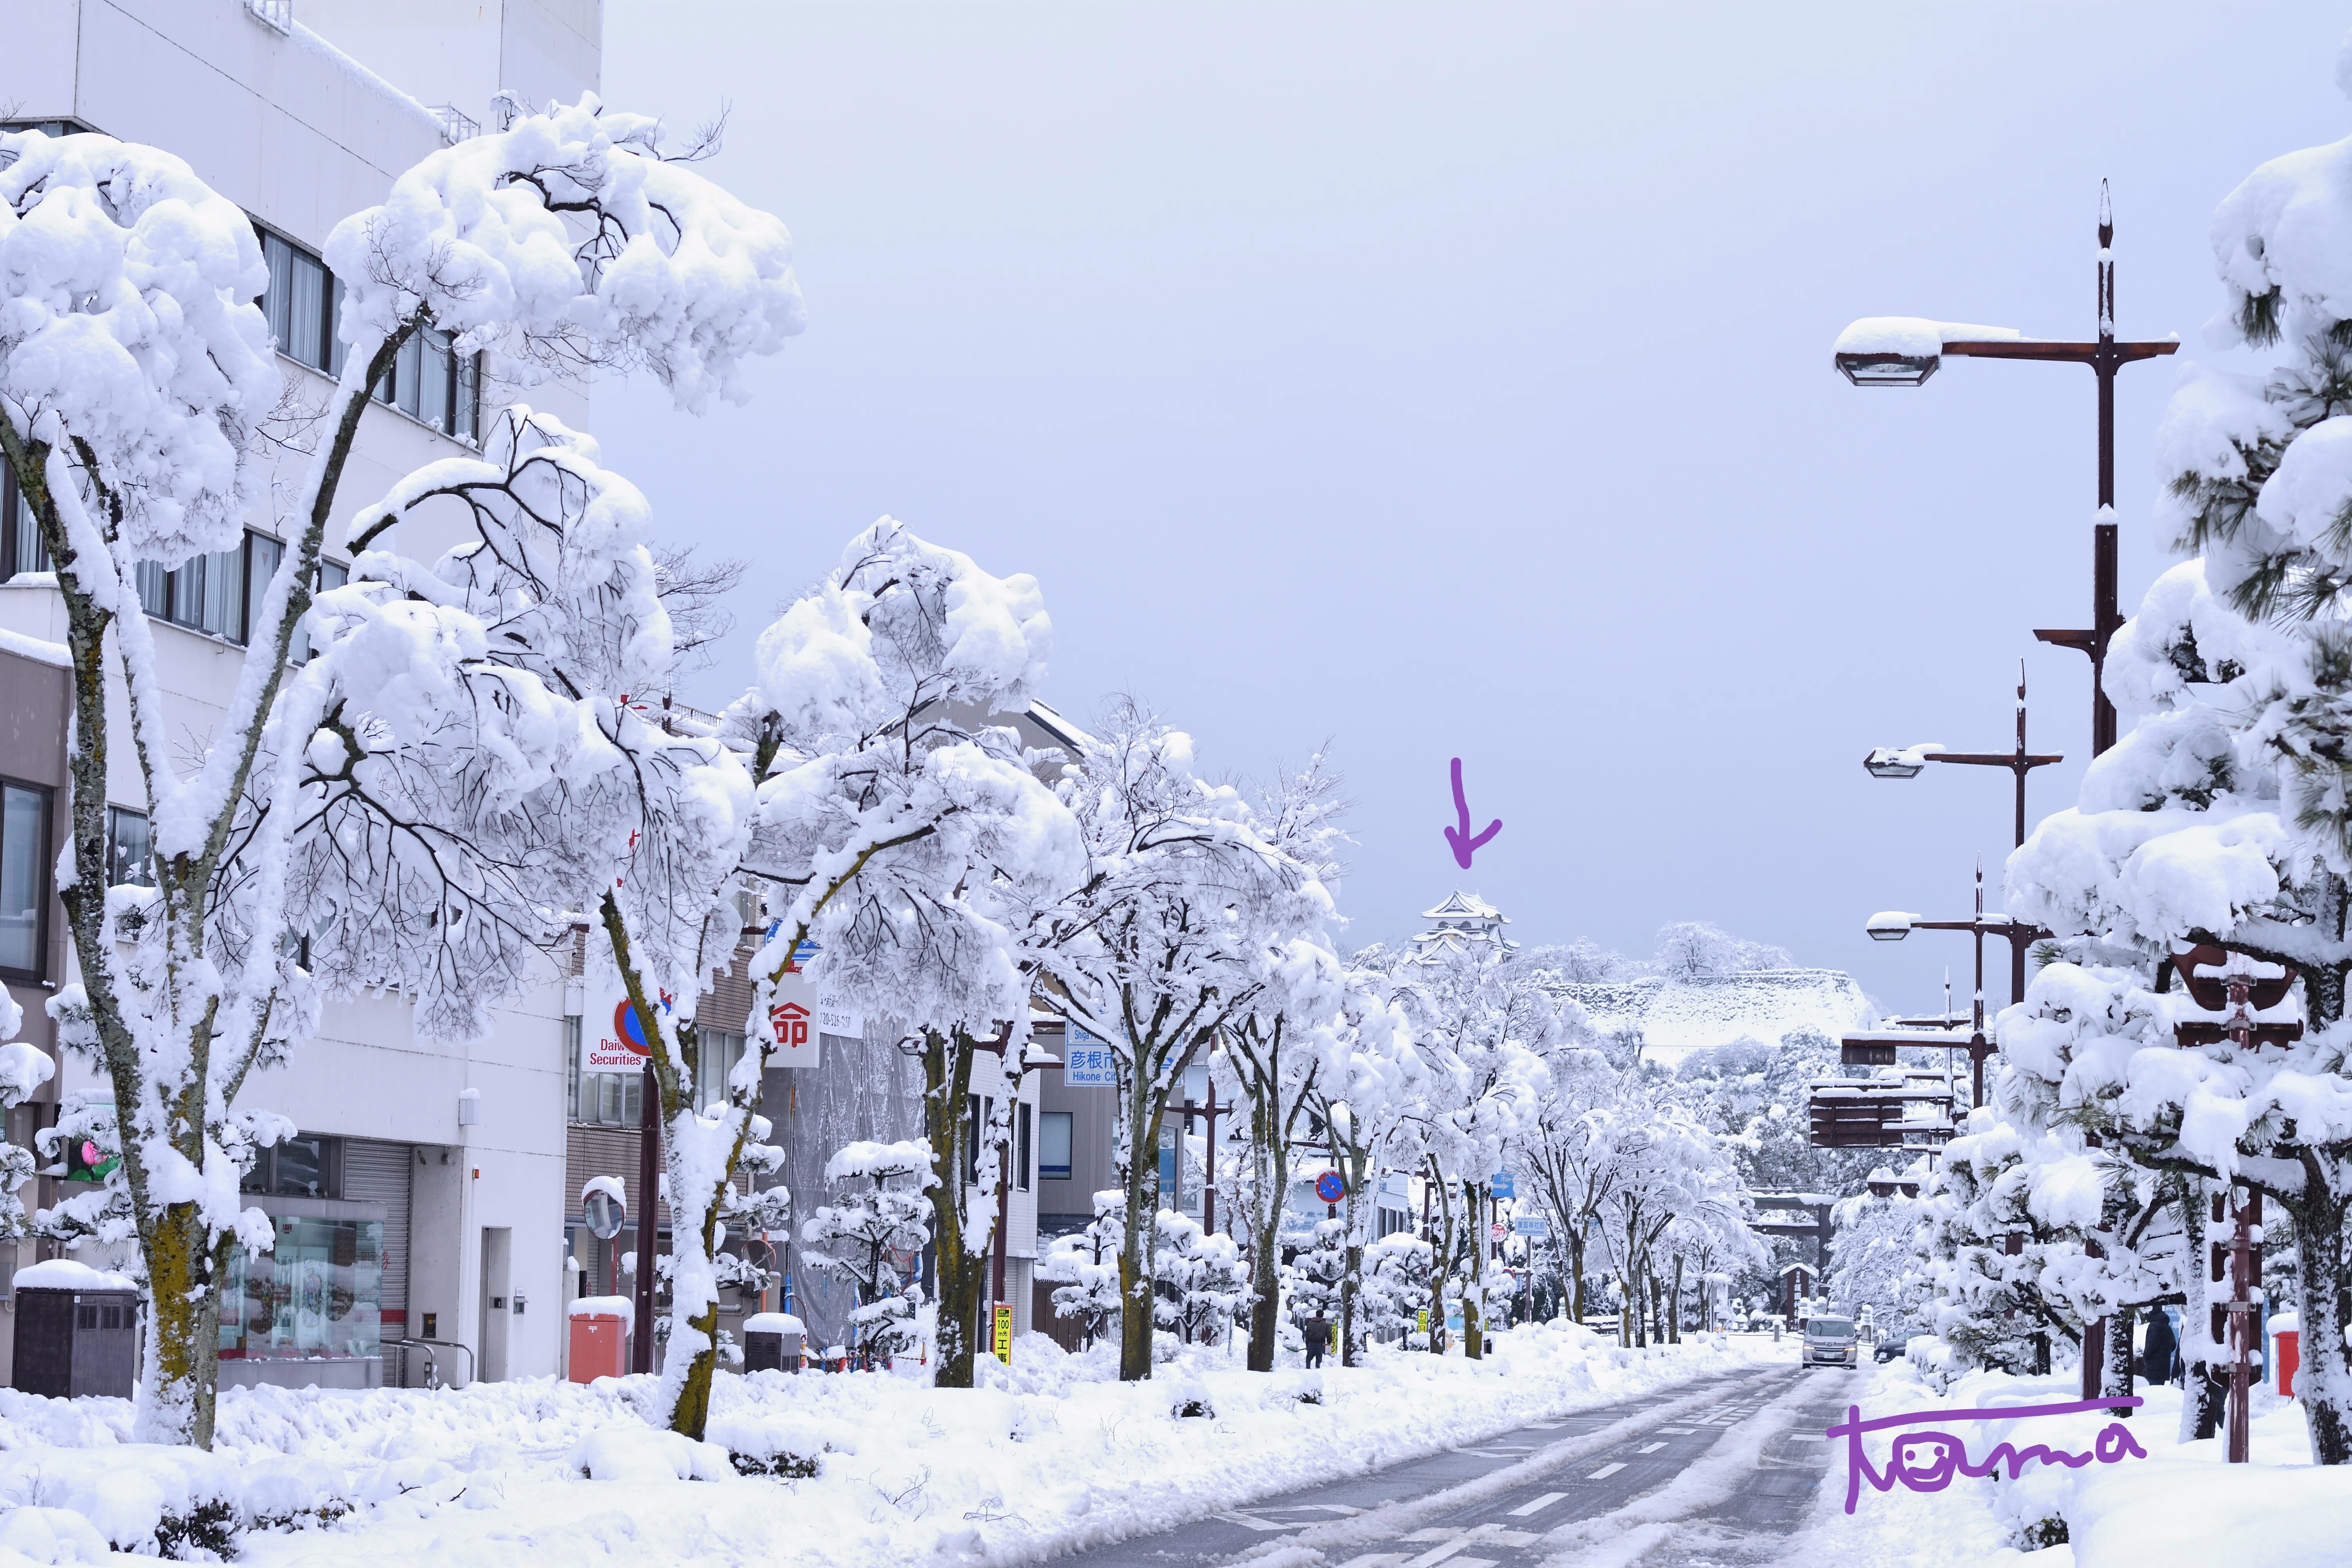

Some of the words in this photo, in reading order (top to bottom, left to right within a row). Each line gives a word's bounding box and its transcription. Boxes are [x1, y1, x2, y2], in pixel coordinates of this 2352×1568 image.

[1074, 1029, 1089, 1041] Shiga
[601, 1039, 627, 1051] Daiw
[590, 1053, 641, 1065] Securities
[1073, 1071, 1101, 1081] Hikone
[1105, 1071, 1116, 1081] Cit
[997, 1320, 1009, 1329] 100
